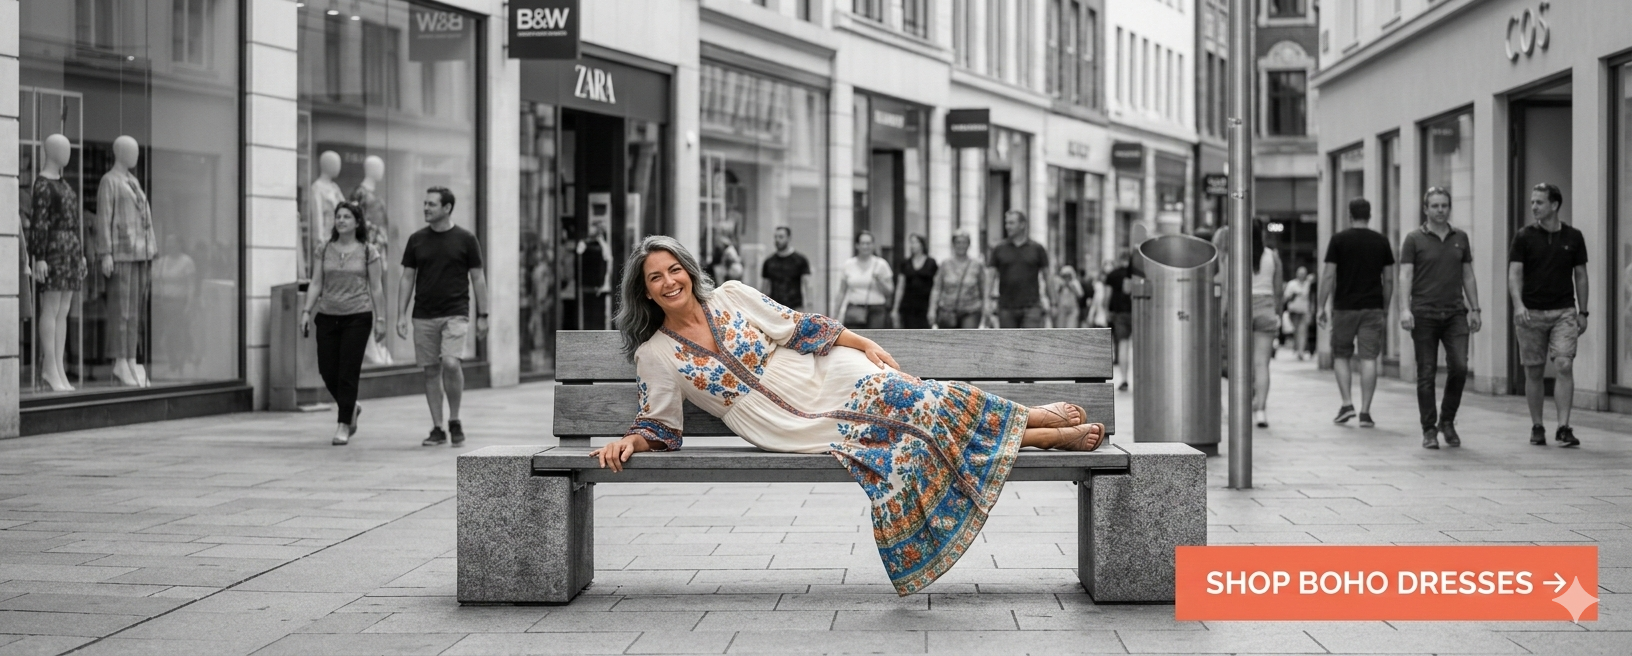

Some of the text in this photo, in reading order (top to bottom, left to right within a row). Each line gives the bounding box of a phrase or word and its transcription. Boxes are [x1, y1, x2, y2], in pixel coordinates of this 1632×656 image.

[517, 7, 570, 30] B&W
[1505, 1, 1551, 64] COS
[574, 64, 616, 104] ZARA
